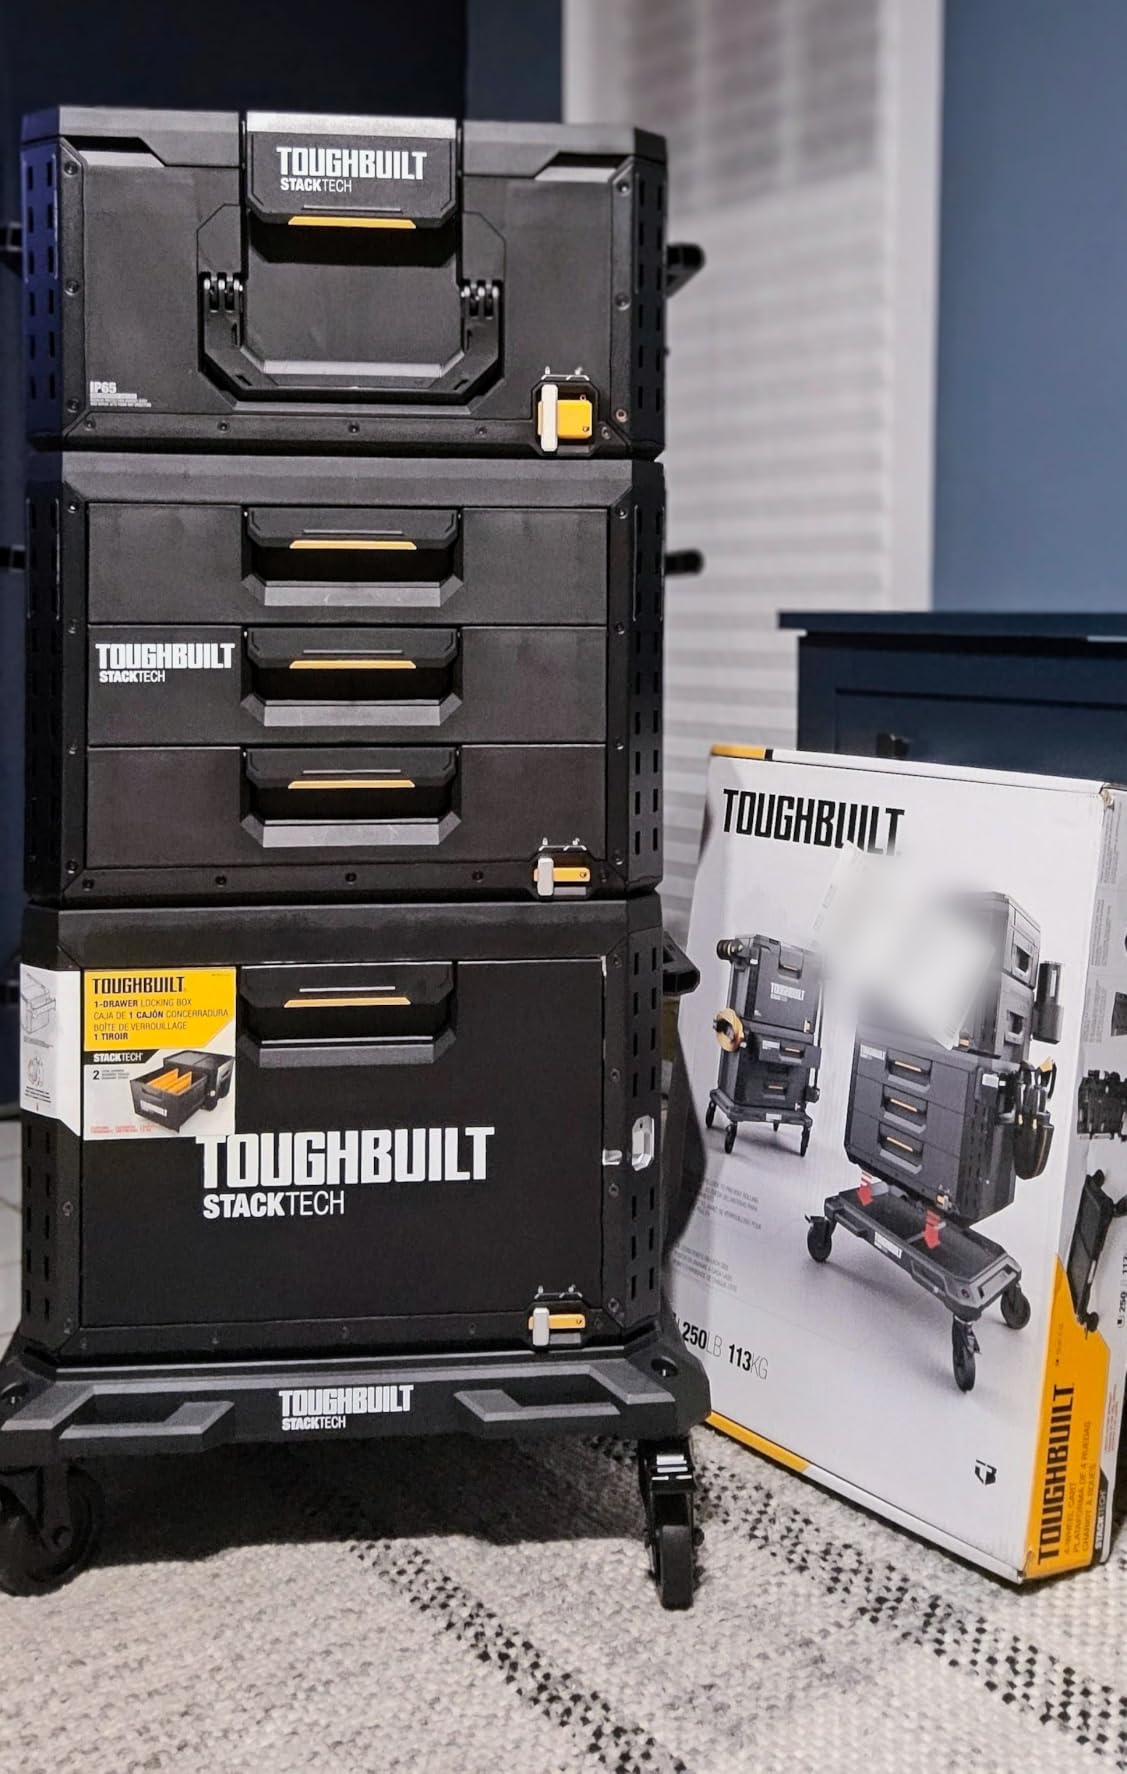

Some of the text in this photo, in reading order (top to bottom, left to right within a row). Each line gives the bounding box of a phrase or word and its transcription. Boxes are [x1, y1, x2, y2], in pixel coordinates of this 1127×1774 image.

[276, 147, 428, 180] TOUGHBUILT
[280, 177, 352, 193] STACKTECH
[90, 381, 117, 393] IP65
[95, 643, 236, 670] TOUGHBUILT
[99, 670, 166, 683] STACKTECH
[723, 788, 905, 856] TOUGHBUILT
[93, 976, 185, 995] TOUGHBUILT
[94, 998, 192, 1009] 1-DRAWER LOCKING BOX
[94, 1011, 114, 1021] CAJA
[116, 1011, 127, 1020] DE
[129, 1011, 133, 1020] 1
[136, 1009, 164, 1019] CAJÓN
[118, 1023, 129, 1032] DE
[131, 1021, 188, 1031] VERROUILLAGE
[94, 1032, 129, 1041] 1 TIROIR
[92, 1069, 101, 1081] 2
[195, 1126, 496, 1189] TOUGHBUILT
[203, 1190, 345, 1219] STACKTECH
[728, 1343, 768, 1380] 113KG
[278, 1384, 415, 1417] TOUGHBUILT
[281, 1415, 347, 1431] STACKTECH
[1038, 1384, 1075, 1565] TOUGHBUILT
